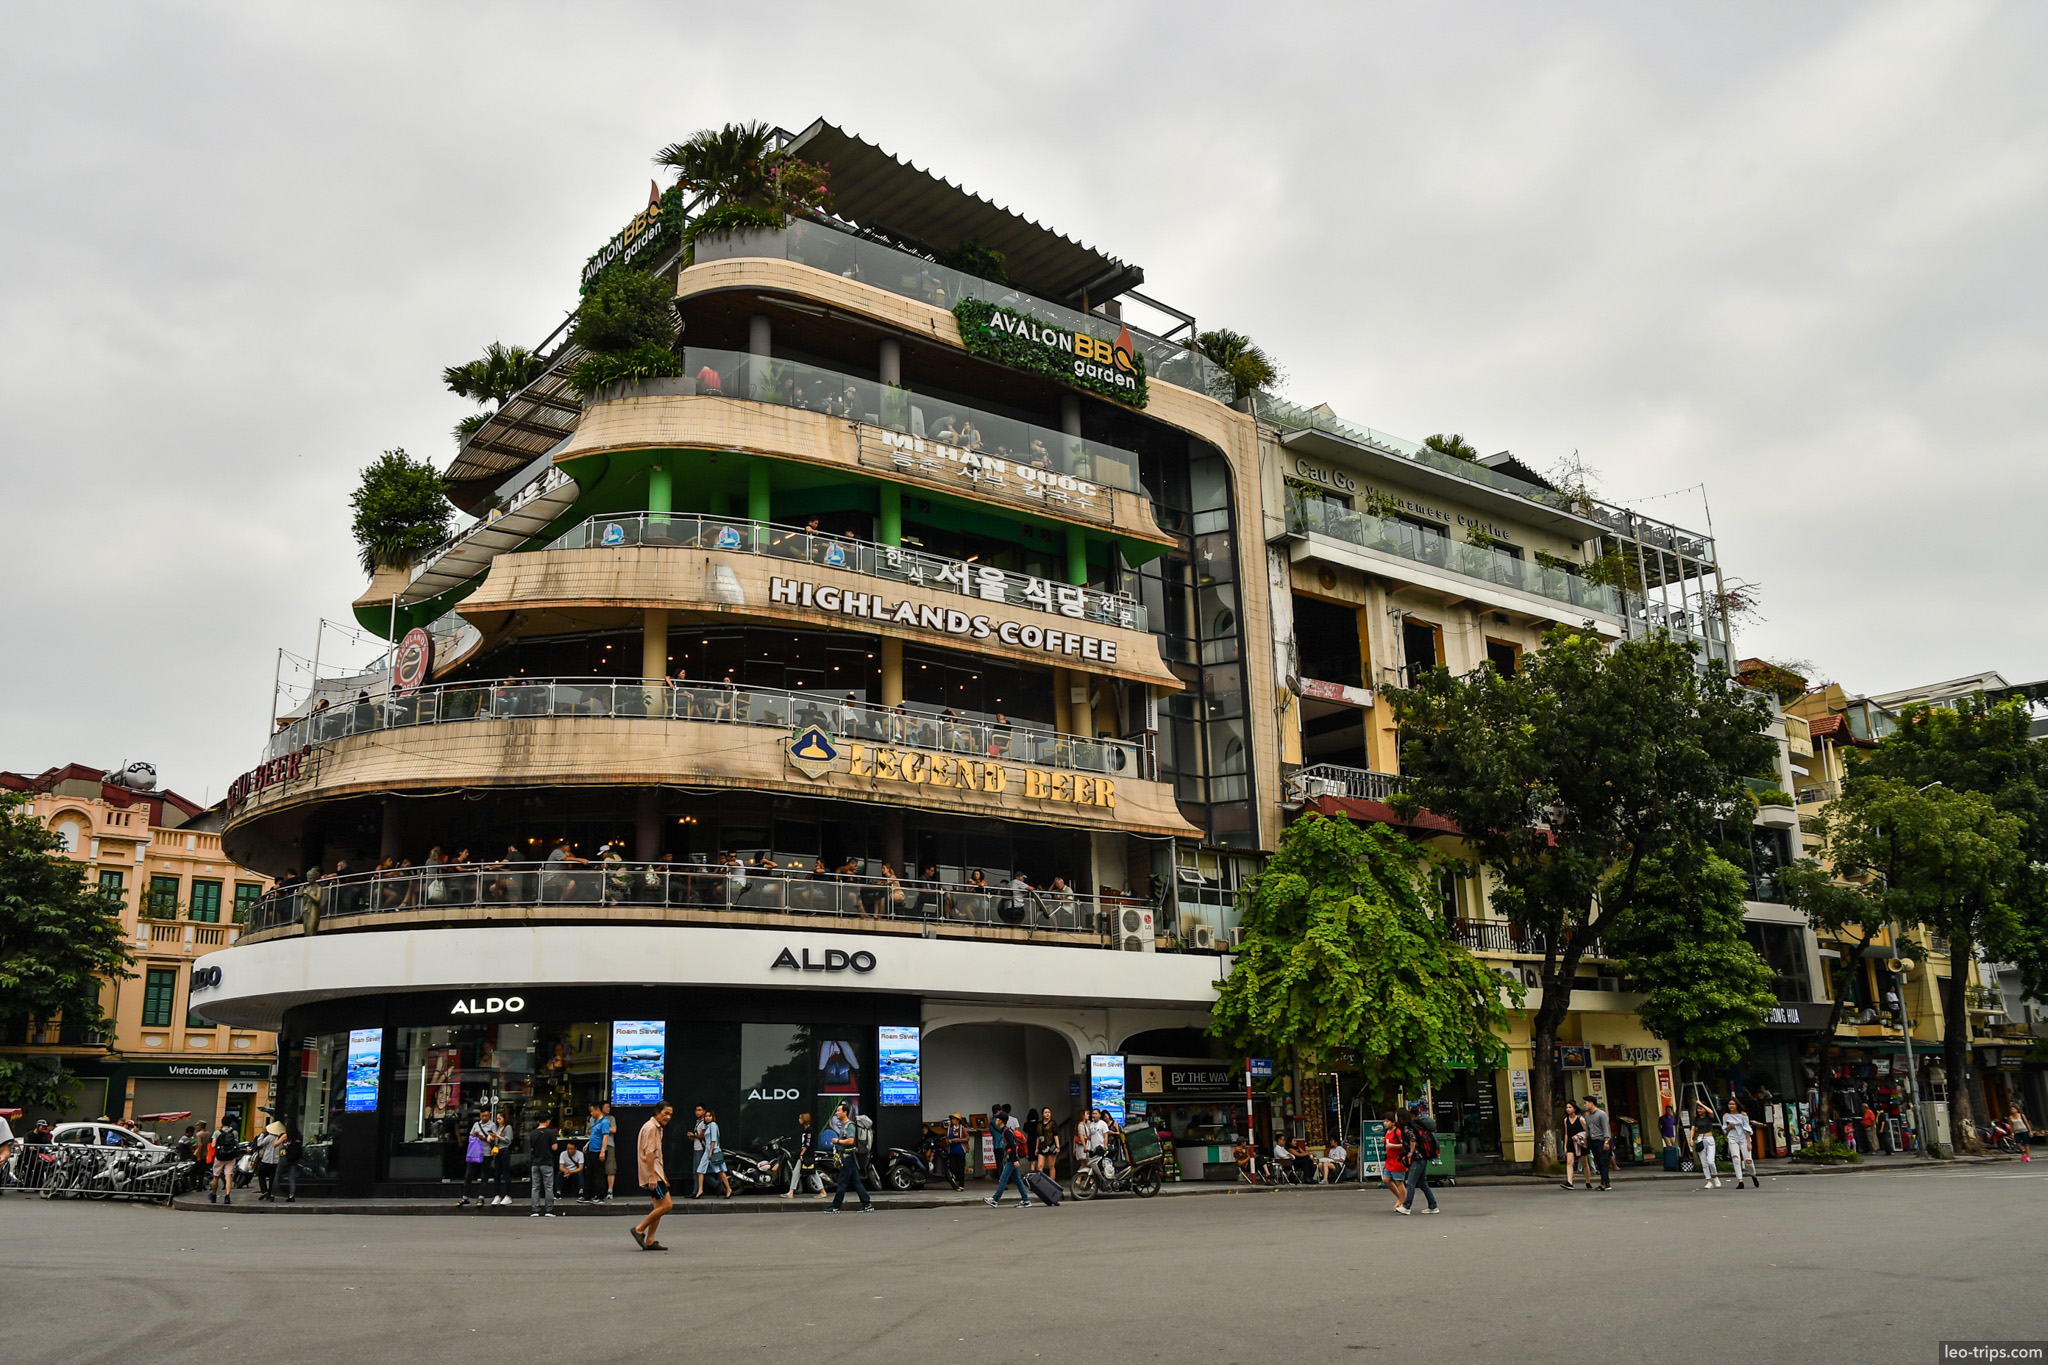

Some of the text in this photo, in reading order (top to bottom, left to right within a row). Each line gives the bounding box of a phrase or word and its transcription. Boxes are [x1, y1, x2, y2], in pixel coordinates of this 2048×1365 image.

[584, 236, 623, 283] AVALON
[624, 222, 661, 265] garden
[990, 311, 1072, 353] AVALON
[1074, 360, 1136, 390] garden
[881, 430, 1098, 497] MÌ HÀN QUỐC
[889, 450, 943, 473] 등촌
[1021, 482, 1095, 509] 칼국수
[1295, 457, 1357, 493] Cau Go
[934, 561, 1009, 603] 서울
[1022, 576, 1089, 619] 식당
[770, 576, 1117, 663] HIGHLANDS COFFEE
[253, 750, 301, 792] BEER
[848, 743, 1116, 808] LEGEND BEER
[769, 946, 877, 974] ALDO
[450, 996, 525, 1015] ALDO
[169, 1065, 230, 1076] Vietcombank
[231, 1082, 254, 1091] ATM
[1172, 1072, 1186, 1083] BY
[1187, 1072, 1207, 1083] THE
[1208, 1072, 1229, 1083] WAY
[747, 1088, 800, 1100] ALDO
